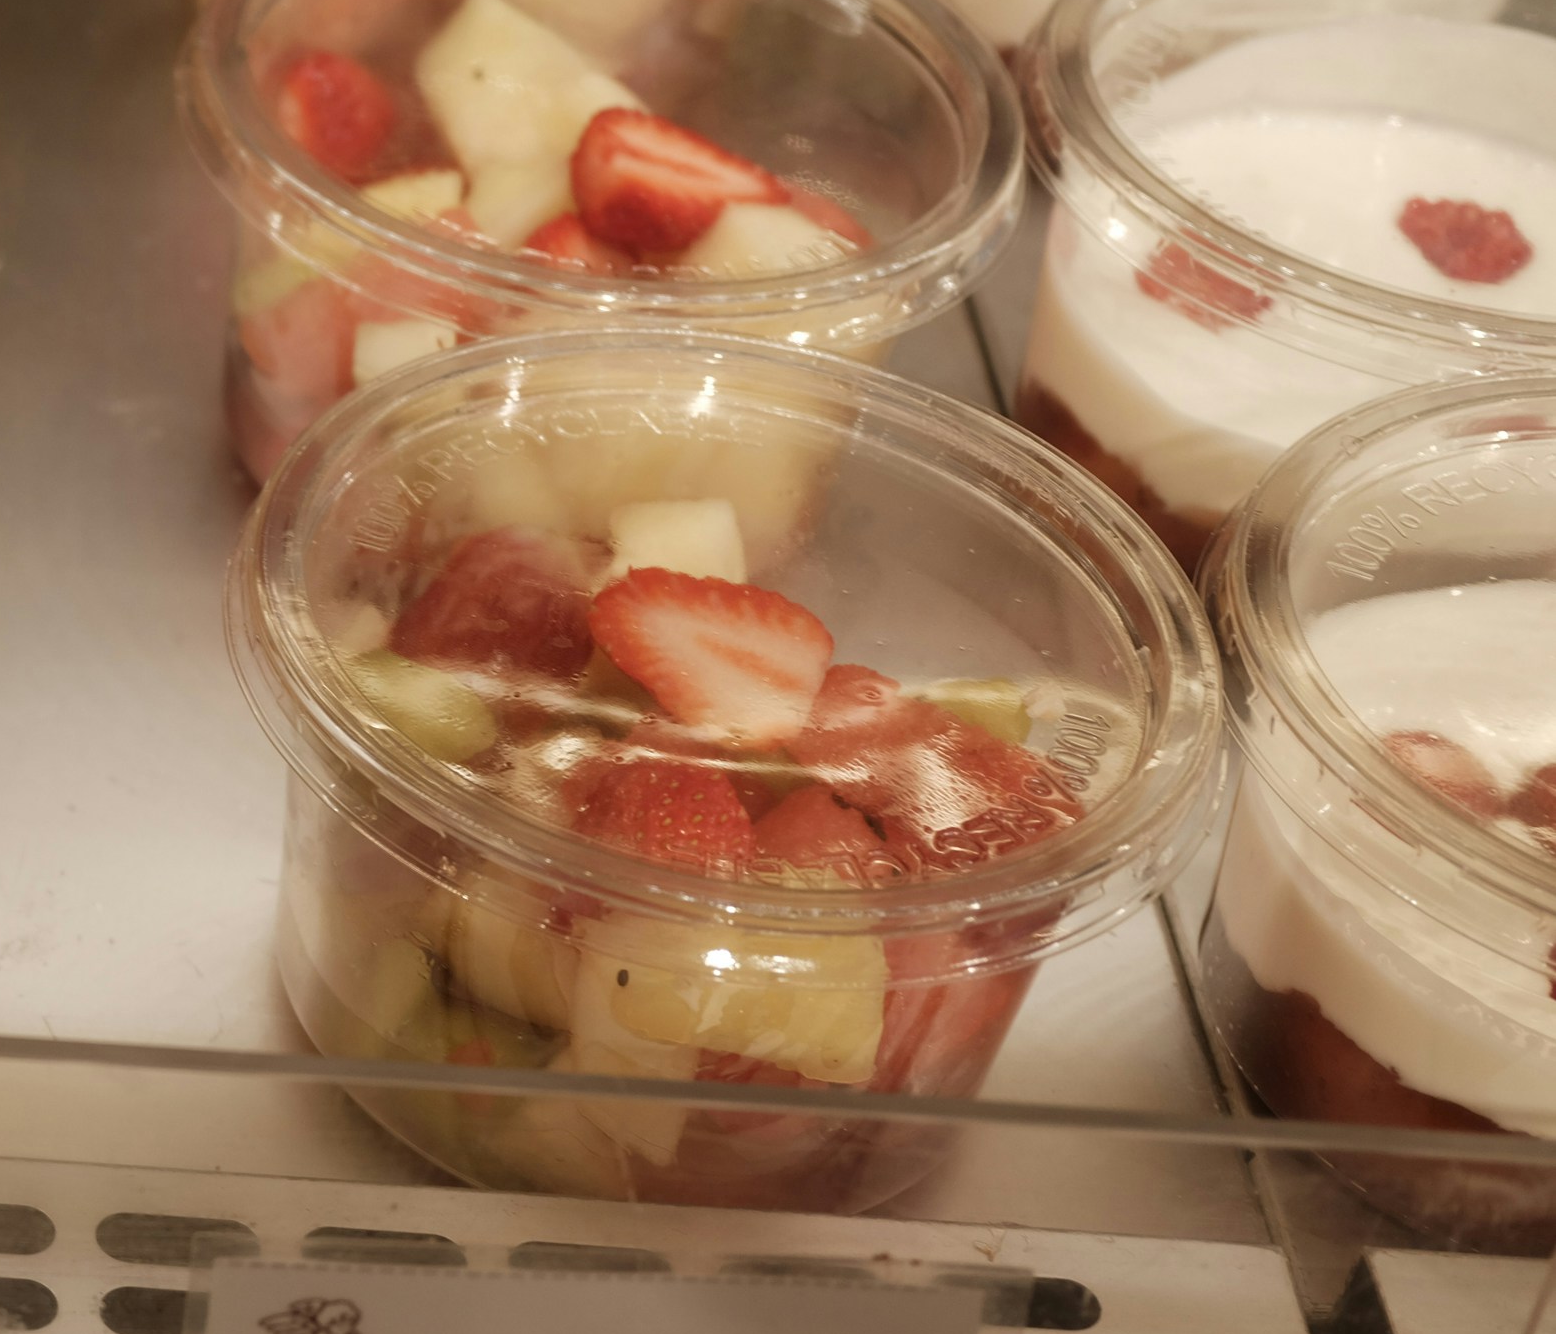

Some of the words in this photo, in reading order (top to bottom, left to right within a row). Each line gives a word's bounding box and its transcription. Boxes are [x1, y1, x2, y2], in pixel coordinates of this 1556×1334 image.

[347, 473, 437, 553] 100%
[1325, 504, 1422, 582] 100%
[1023, 712, 1112, 805] 100%
